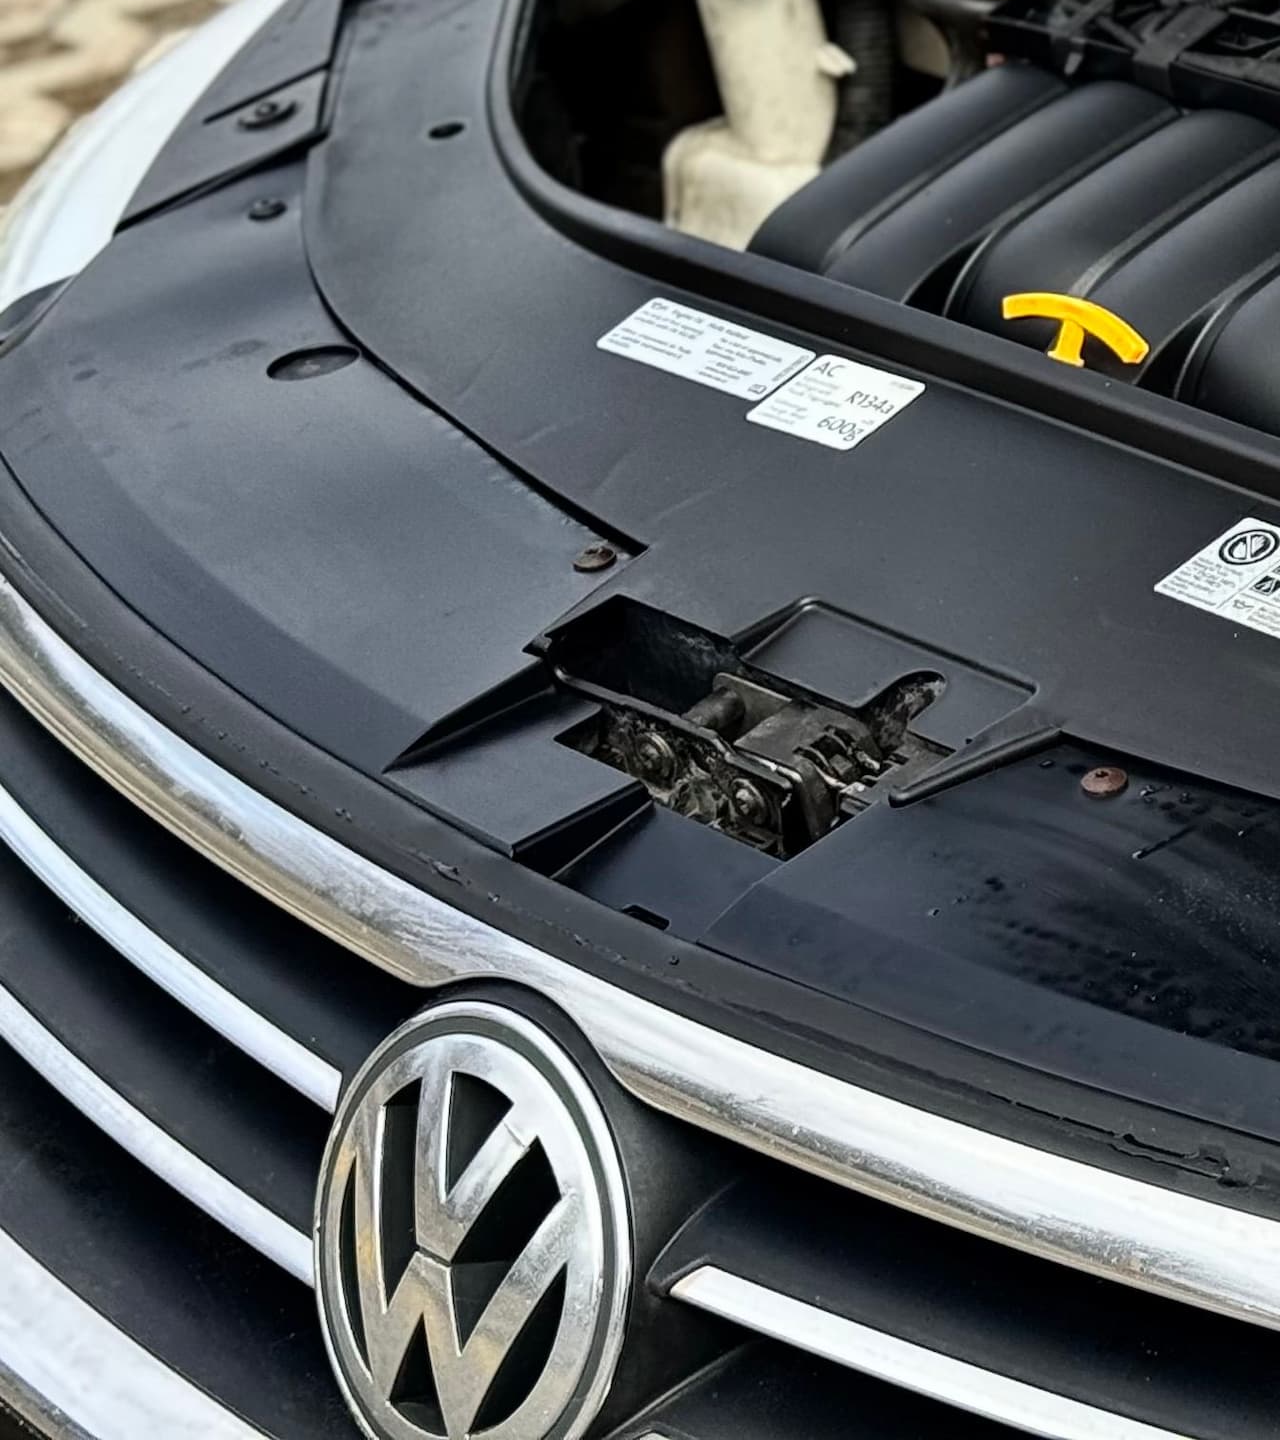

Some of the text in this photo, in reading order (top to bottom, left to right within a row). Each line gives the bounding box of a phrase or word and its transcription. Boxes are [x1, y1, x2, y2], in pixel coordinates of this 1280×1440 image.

[813, 361, 846, 377] AC
[845, 391, 895, 414] R134a
[330, 1035, 600, 1440] VW
